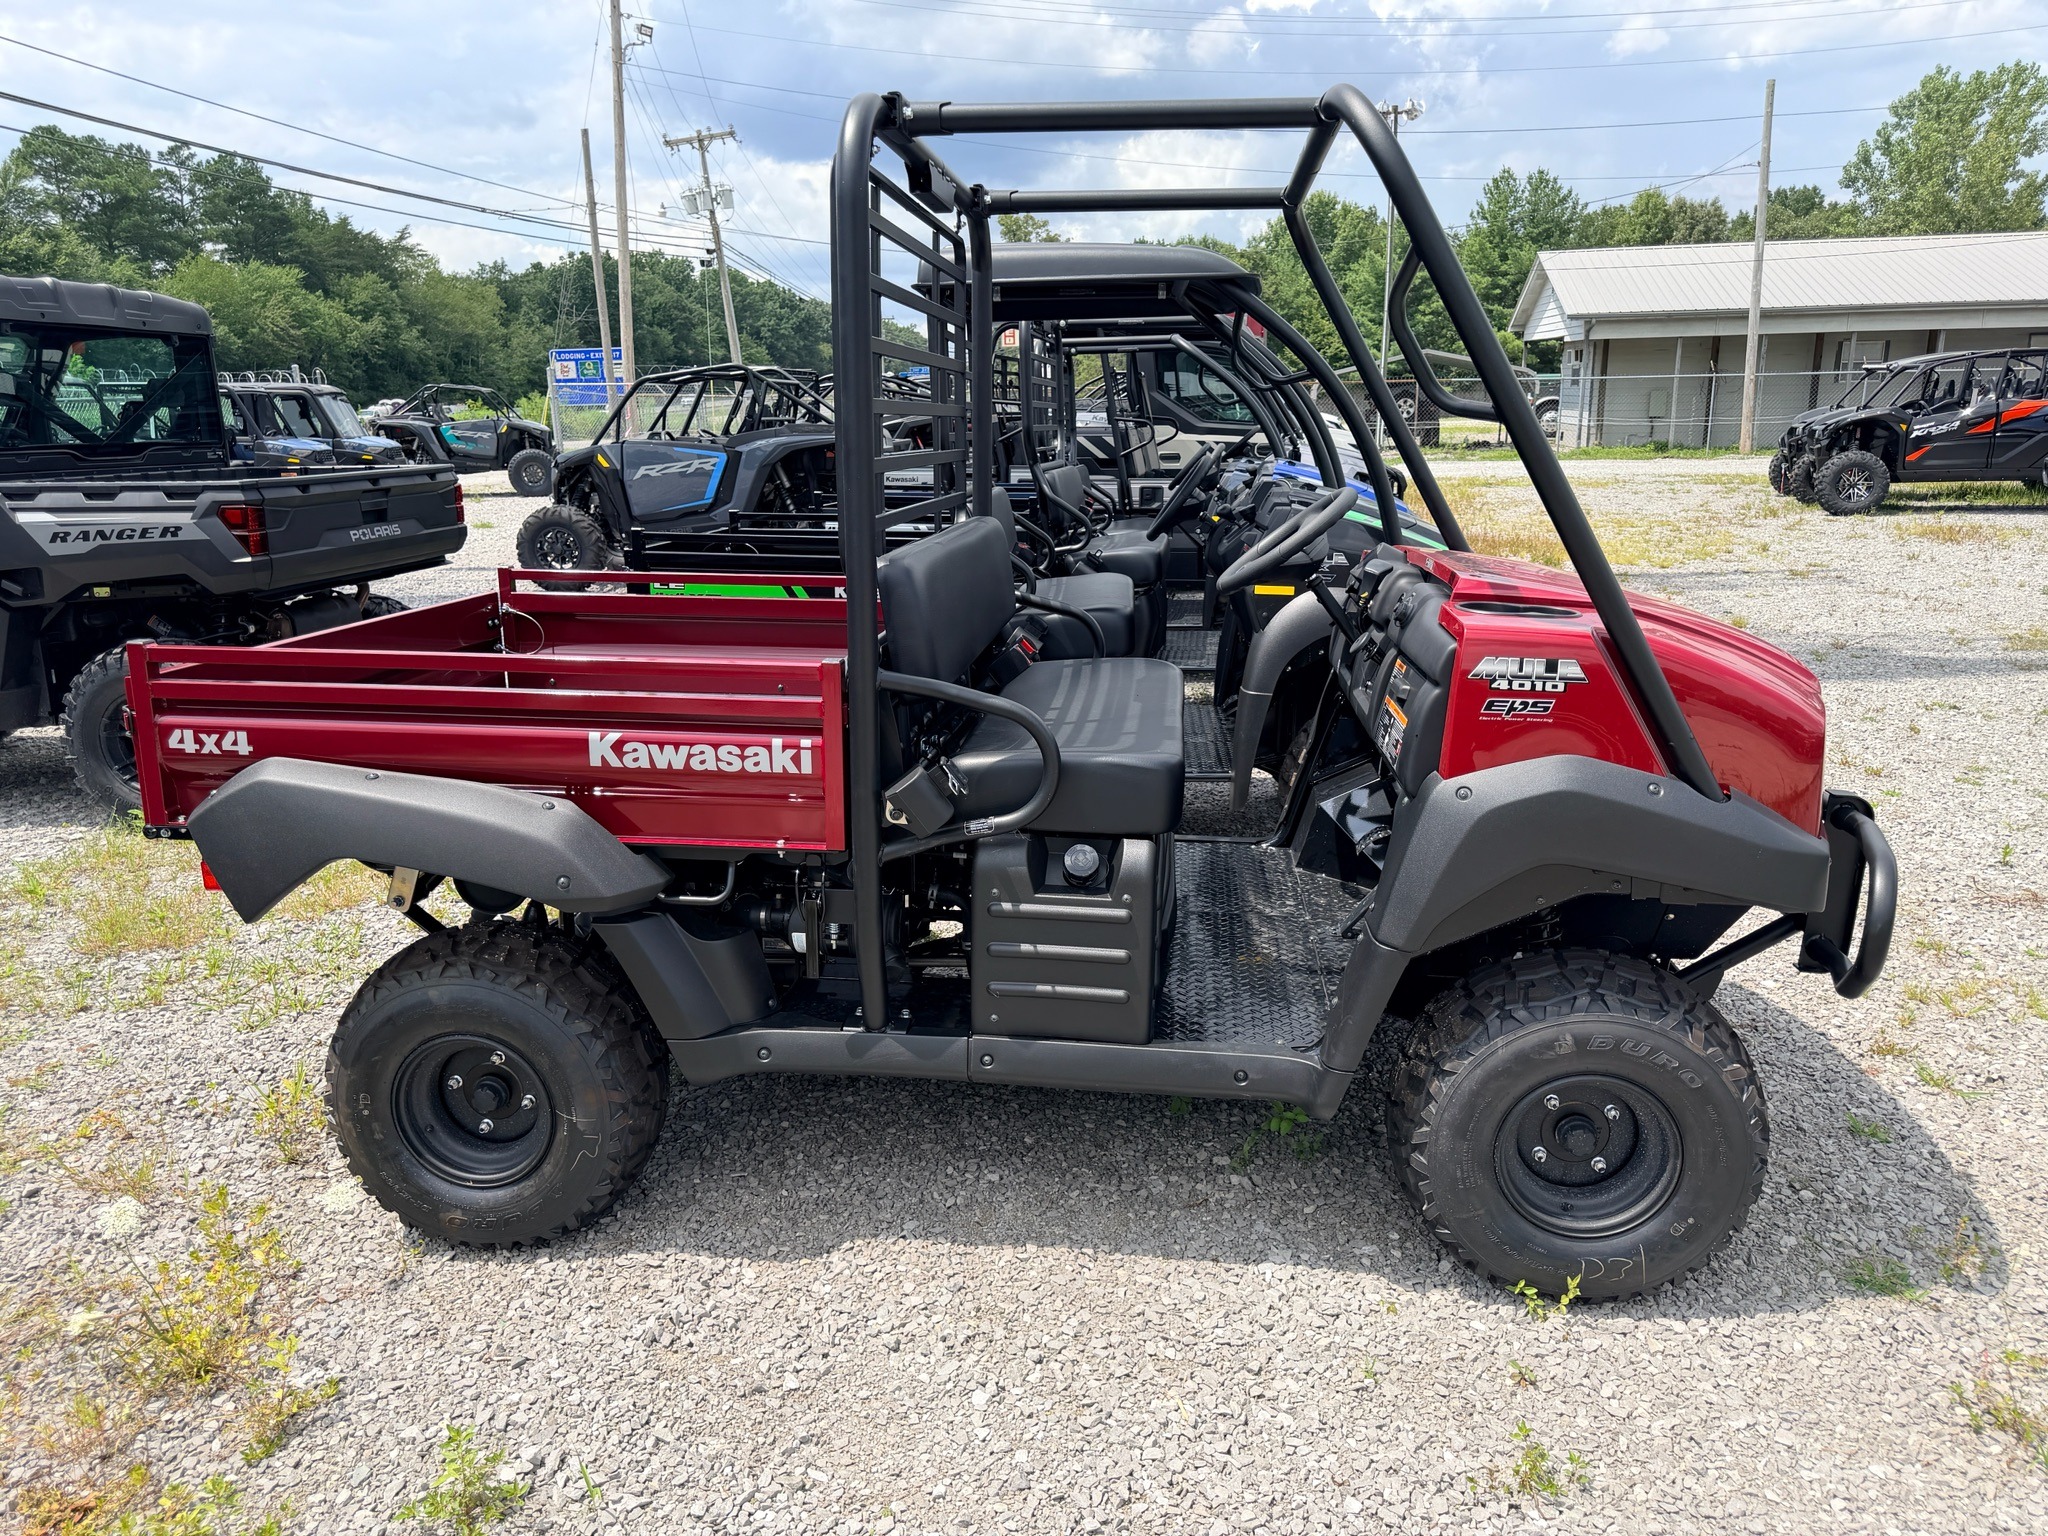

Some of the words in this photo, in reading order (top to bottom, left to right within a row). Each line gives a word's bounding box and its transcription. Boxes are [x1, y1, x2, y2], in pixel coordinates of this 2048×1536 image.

[556, 352, 585, 360] LODGING
[446, 430, 493, 439] RZR
[632, 458, 719, 480] RZR
[48, 525, 183, 544] RANGER
[349, 524, 402, 542] POLARIS
[1467, 656, 1589, 683] MULE
[1490, 680, 1565, 692] 4010
[168, 729, 254, 755] 4x4
[587, 731, 813, 775] Kawasaki
[1586, 1034, 1704, 1089] DURO
